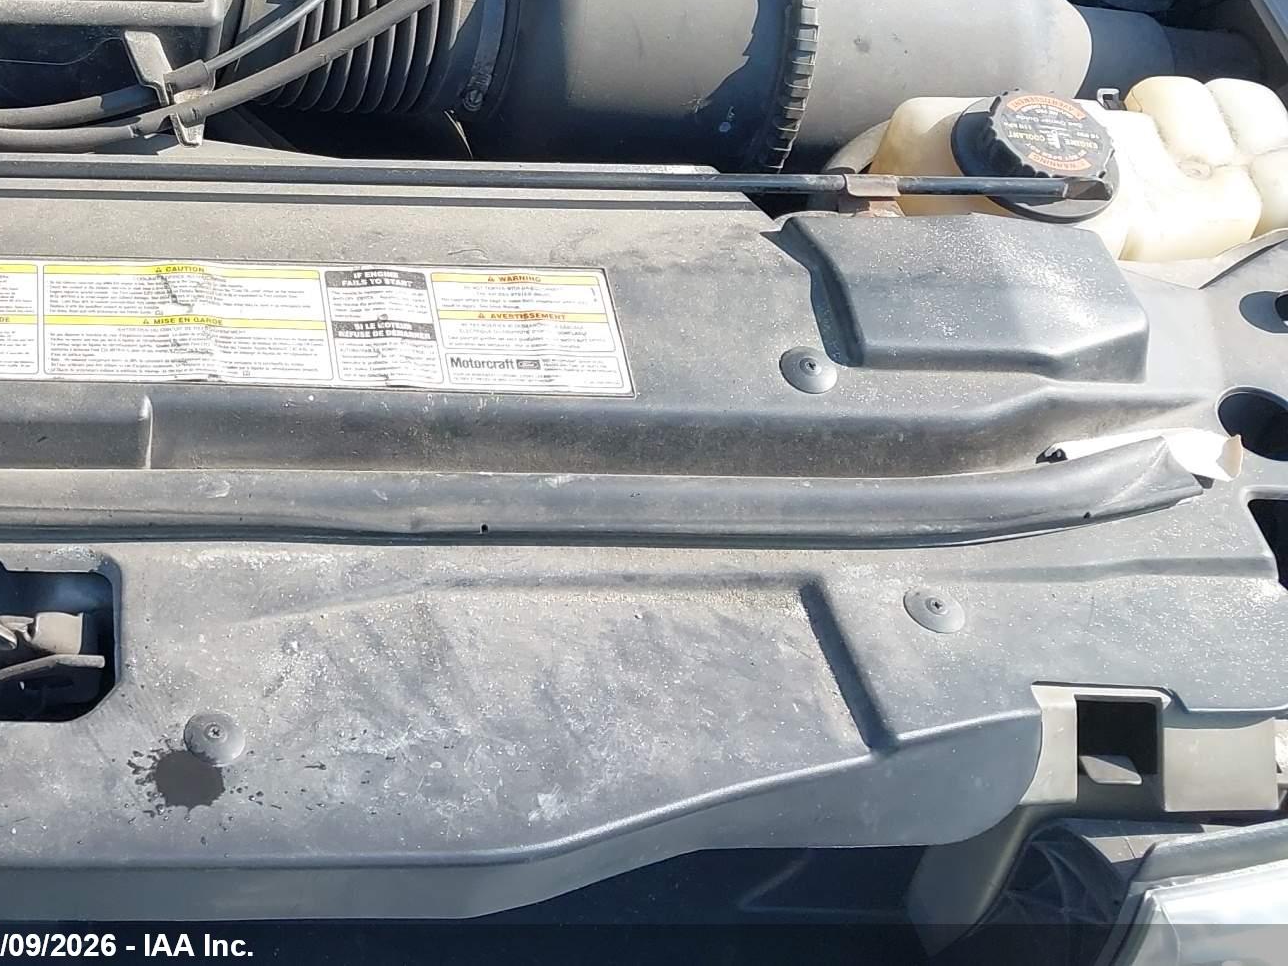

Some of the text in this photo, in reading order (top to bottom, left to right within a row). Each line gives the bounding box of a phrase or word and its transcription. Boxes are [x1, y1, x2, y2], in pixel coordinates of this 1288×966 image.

[1007, 130, 1099, 150] ENGINE COOLANT
[165, 265, 205, 273] CAUTION
[341, 279, 368, 287] FAILS
[384, 278, 414, 288] START
[498, 275, 542, 283] WARNING
[153, 317, 176, 325] MISE
[193, 316, 223, 326] GARDE
[490, 312, 566, 321] AVERTISSEMENT
[450, 356, 515, 370] Motorcraft
